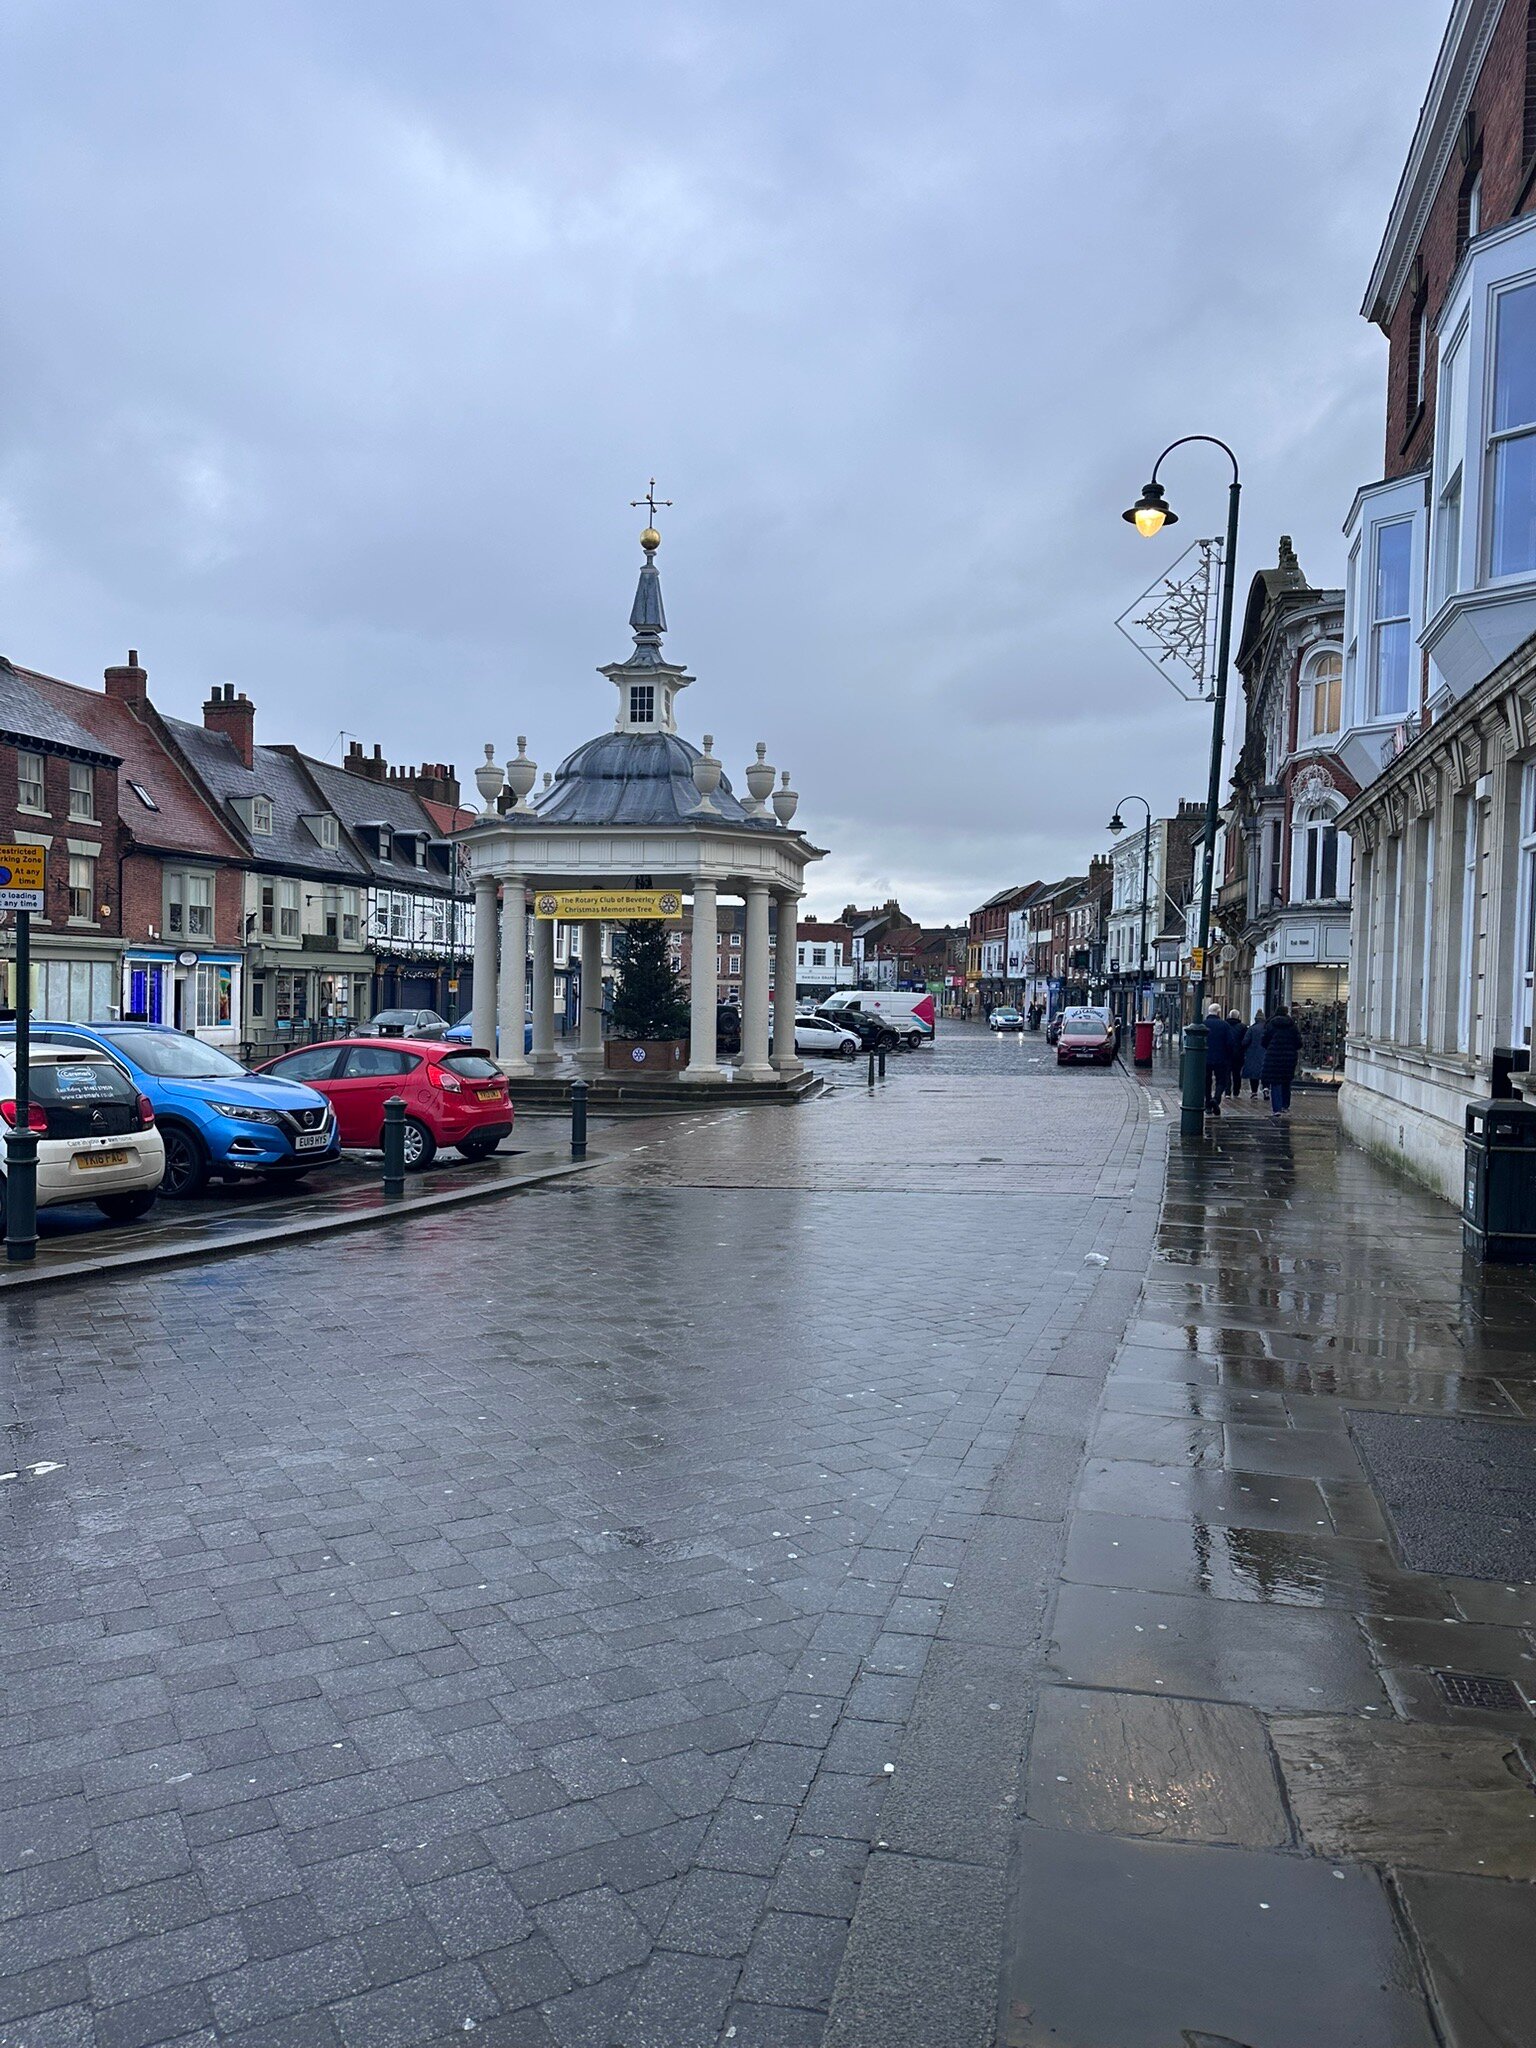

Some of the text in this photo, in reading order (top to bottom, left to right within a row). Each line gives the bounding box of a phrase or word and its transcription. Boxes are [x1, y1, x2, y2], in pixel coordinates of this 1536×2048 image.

[575, 896, 598, 904] Rotary
[625, 896, 656, 904] Beverley
[300, 1135, 327, 1147] EU19 HYS
